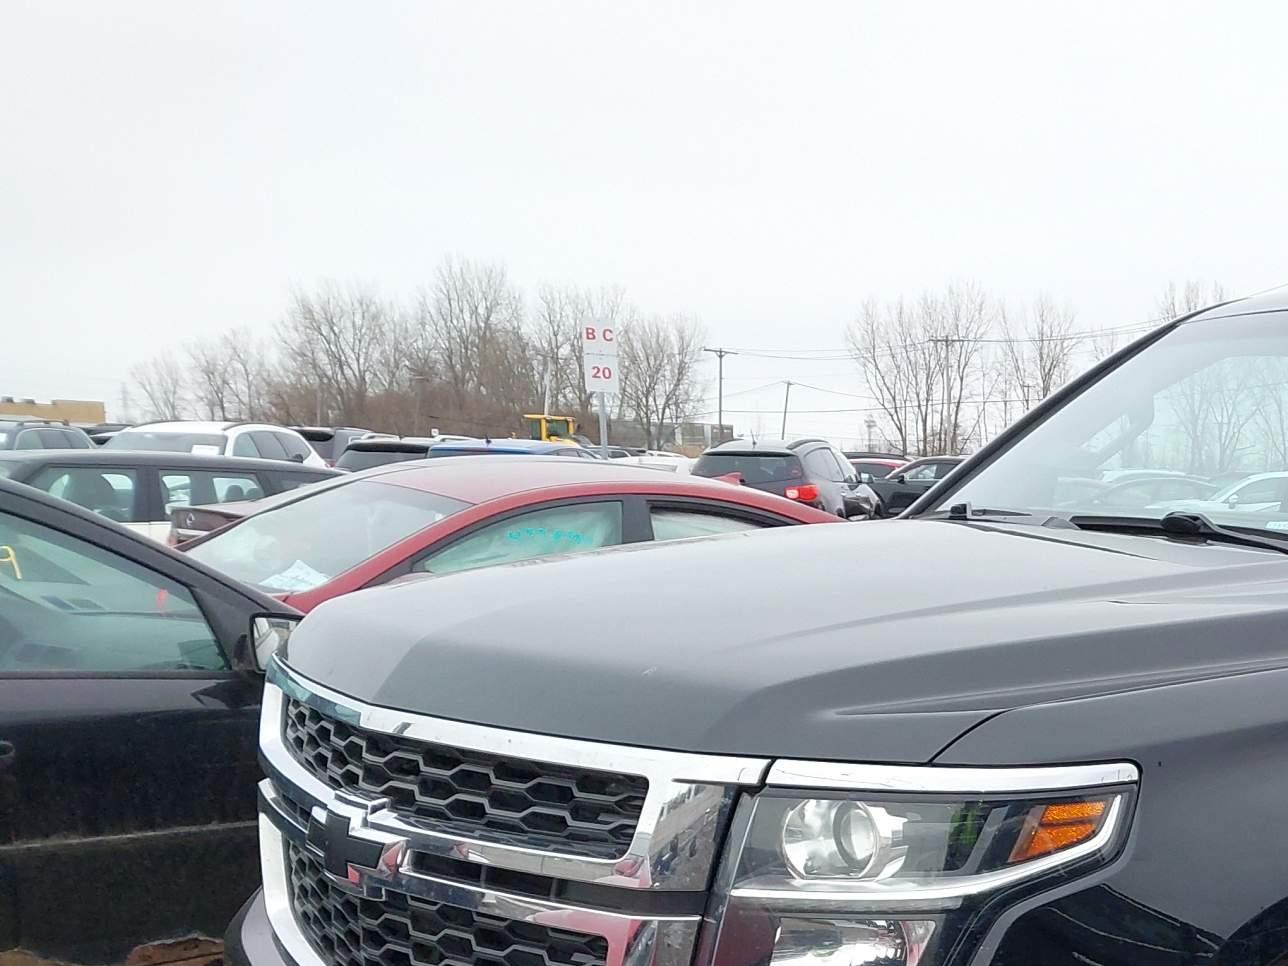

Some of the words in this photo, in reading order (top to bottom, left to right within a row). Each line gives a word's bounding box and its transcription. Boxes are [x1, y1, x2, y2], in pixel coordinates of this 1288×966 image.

[585, 327, 597, 341] B
[602, 328, 614, 342] C
[591, 366, 612, 380] 20
